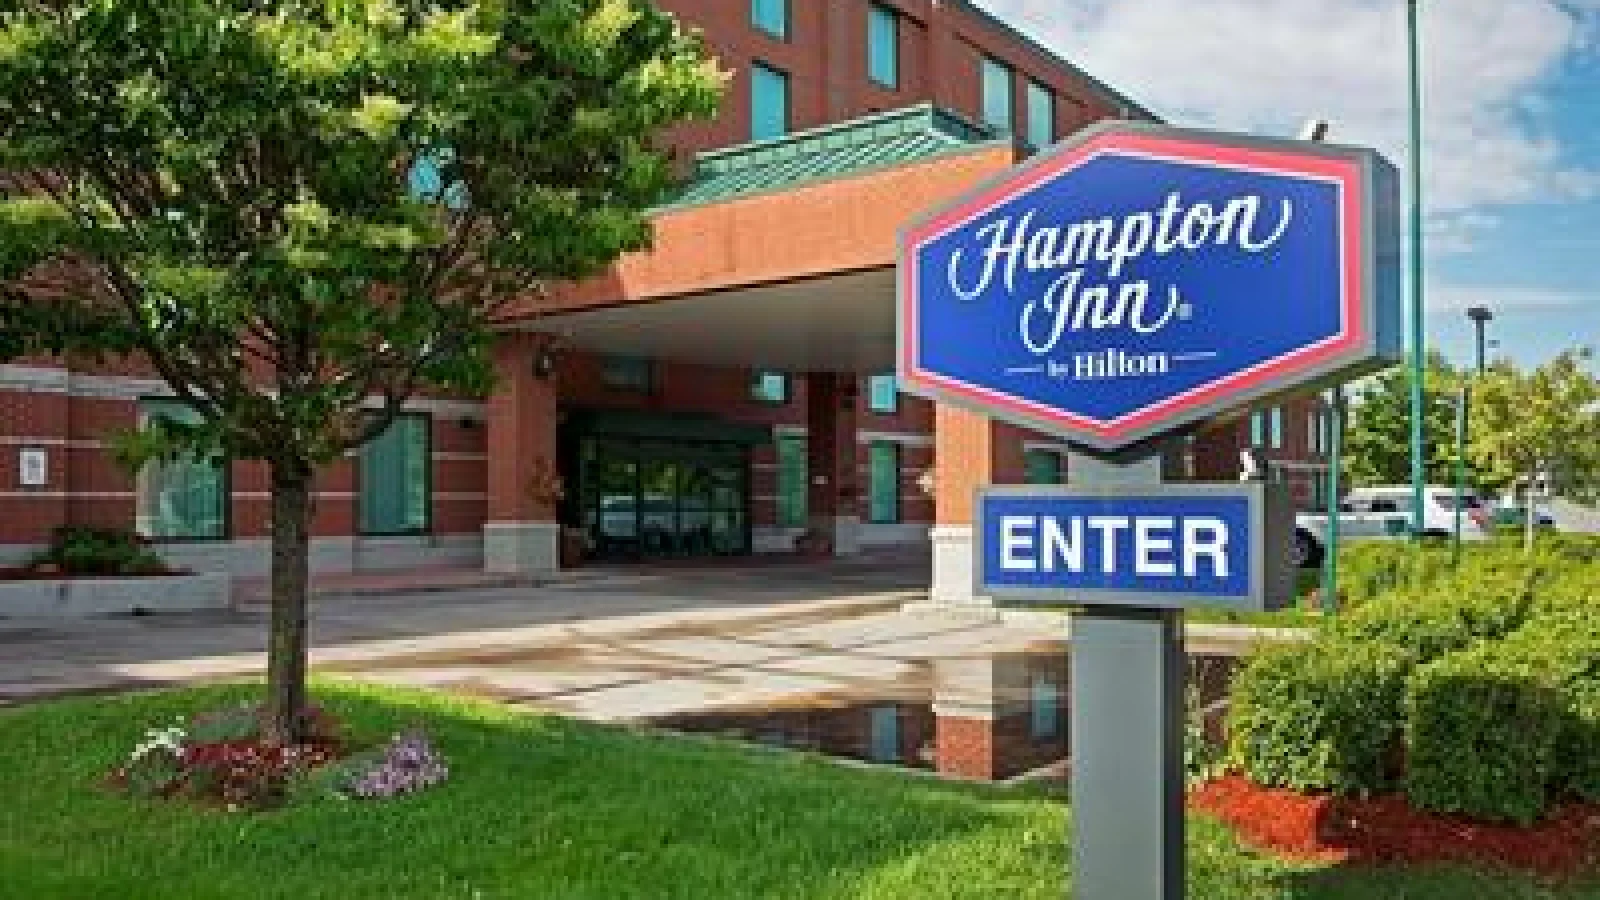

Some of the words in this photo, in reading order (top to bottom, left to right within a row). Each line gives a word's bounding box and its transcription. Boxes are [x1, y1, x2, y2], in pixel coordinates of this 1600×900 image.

[949, 193, 1292, 299] Hampton
[1021, 268, 1179, 353] Inn
[1074, 347, 1169, 380] Hilton
[1000, 515, 1229, 577] ENTER
